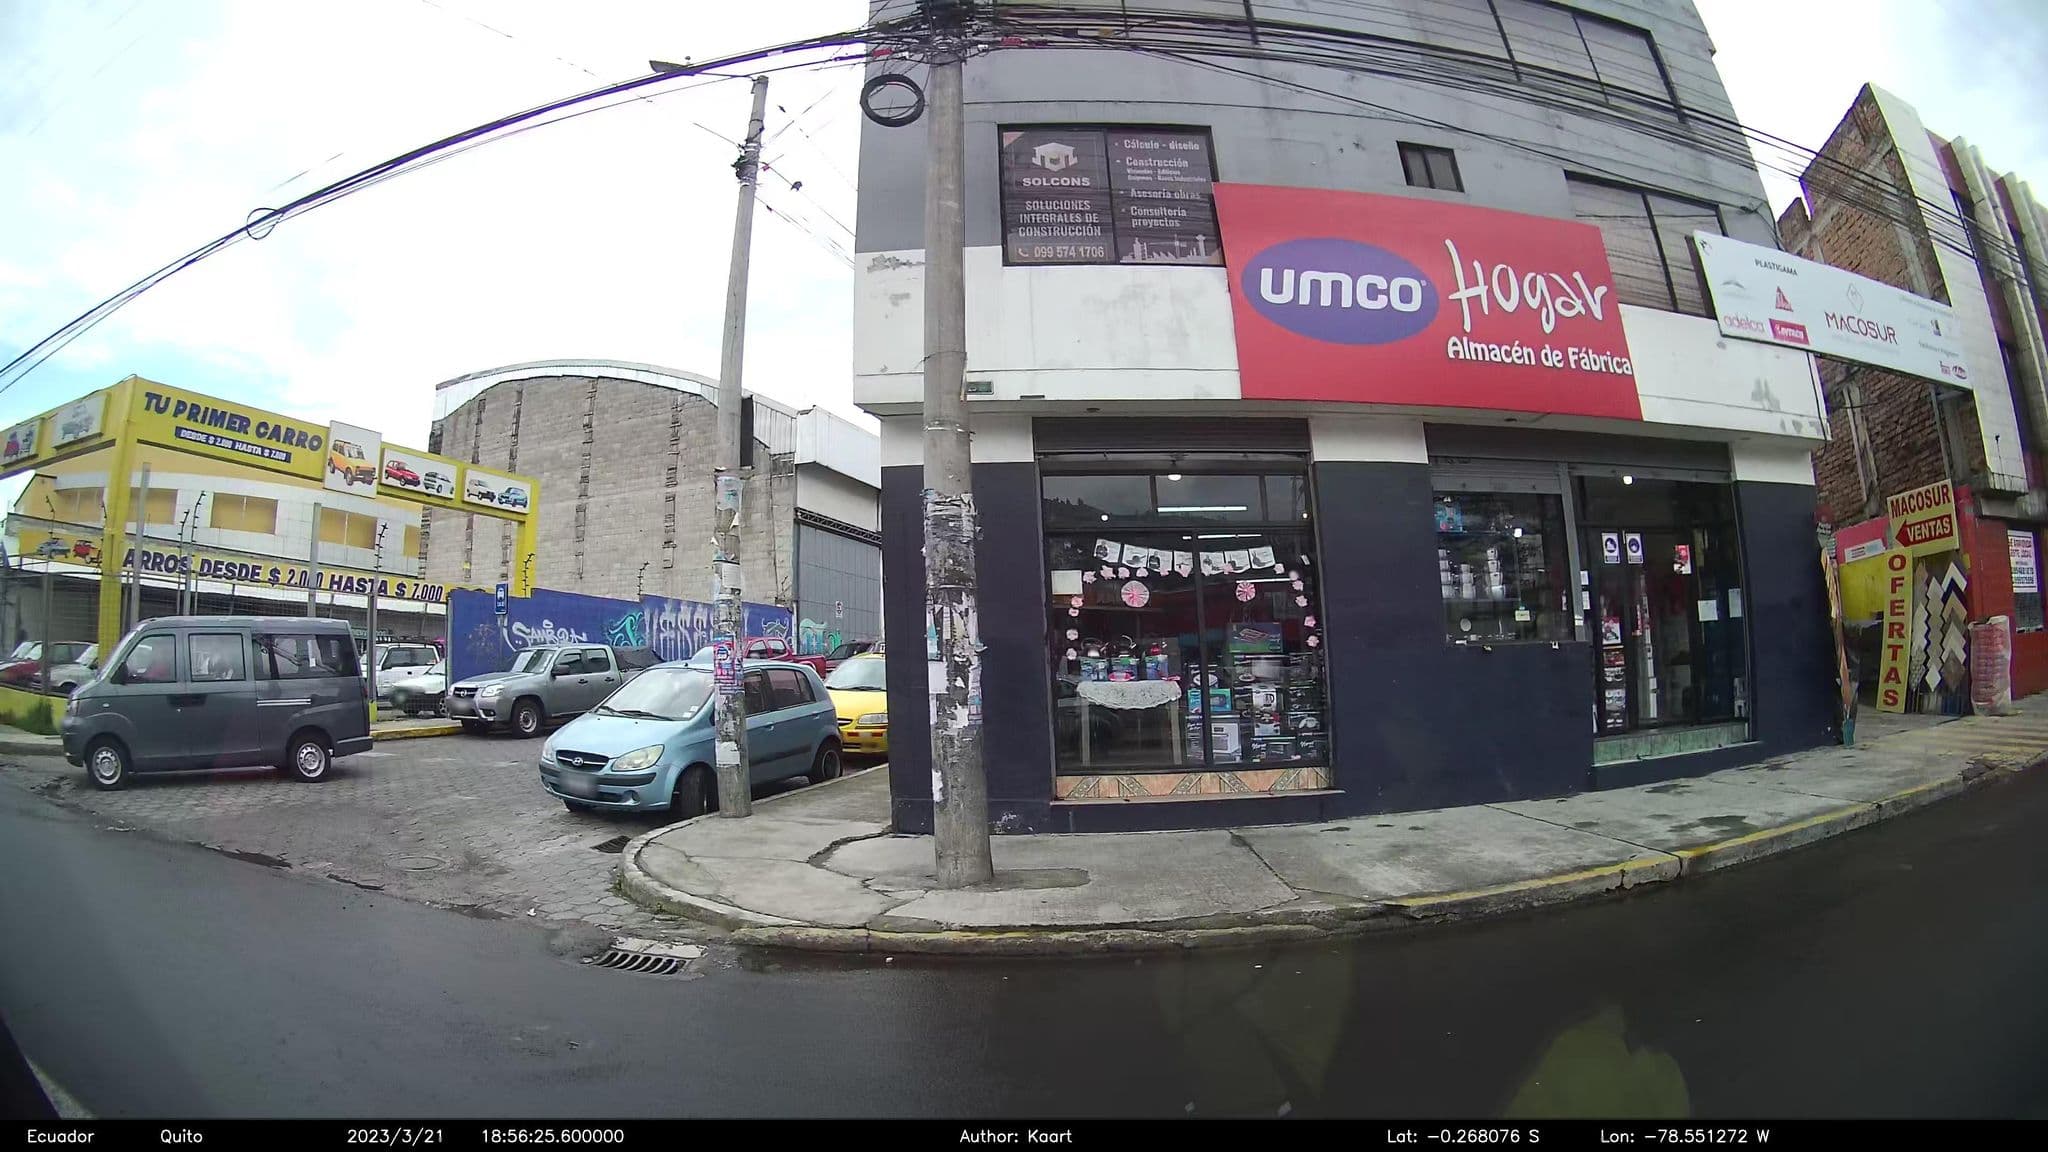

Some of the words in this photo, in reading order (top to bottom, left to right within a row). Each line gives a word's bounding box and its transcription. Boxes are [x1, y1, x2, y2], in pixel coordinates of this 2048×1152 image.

[1126, 156, 1189, 168] Construcción
[1022, 177, 1091, 187] SOLCONS
[1019, 213, 1082, 223] INTEGRALES
[1085, 213, 1099, 223] DE
[1025, 200, 1091, 211] SOLUCIONES
[1130, 206, 1187, 217] Consultoría
[1018, 224, 1101, 237] CONSTRUCCIÓN
[1131, 217, 1181, 228] proyectos
[1034, 246, 1054, 258] 099
[1056, 246, 1077, 258] 574
[1079, 245, 1105, 258] 1706
[1445, 239, 1608, 334] Hogar
[1824, 310, 1898, 345] MACOSUR
[1447, 335, 1536, 366] Almacén
[1541, 344, 1564, 369] de
[1567, 346, 1633, 376] Fábrica
[144, 391, 171, 414] TU
[172, 399, 251, 435] PRIMER
[255, 421, 323, 452] CARRO
[180, 428, 208, 444] DESDE
[235, 443, 262, 455] HASTA
[1891, 484, 1951, 518] MACOSUR
[1907, 517, 1951, 542] VENTAS
[122, 548, 192, 574] ARROS
[199, 558, 262, 583] DESDE
[267, 567, 281, 587] $
[286, 568, 324, 588] 2.00
[329, 573, 388, 596] HASTA
[395, 581, 407, 597] $
[411, 582, 444, 601] 7.000
[1883, 554, 1907, 706] OFERTAS
